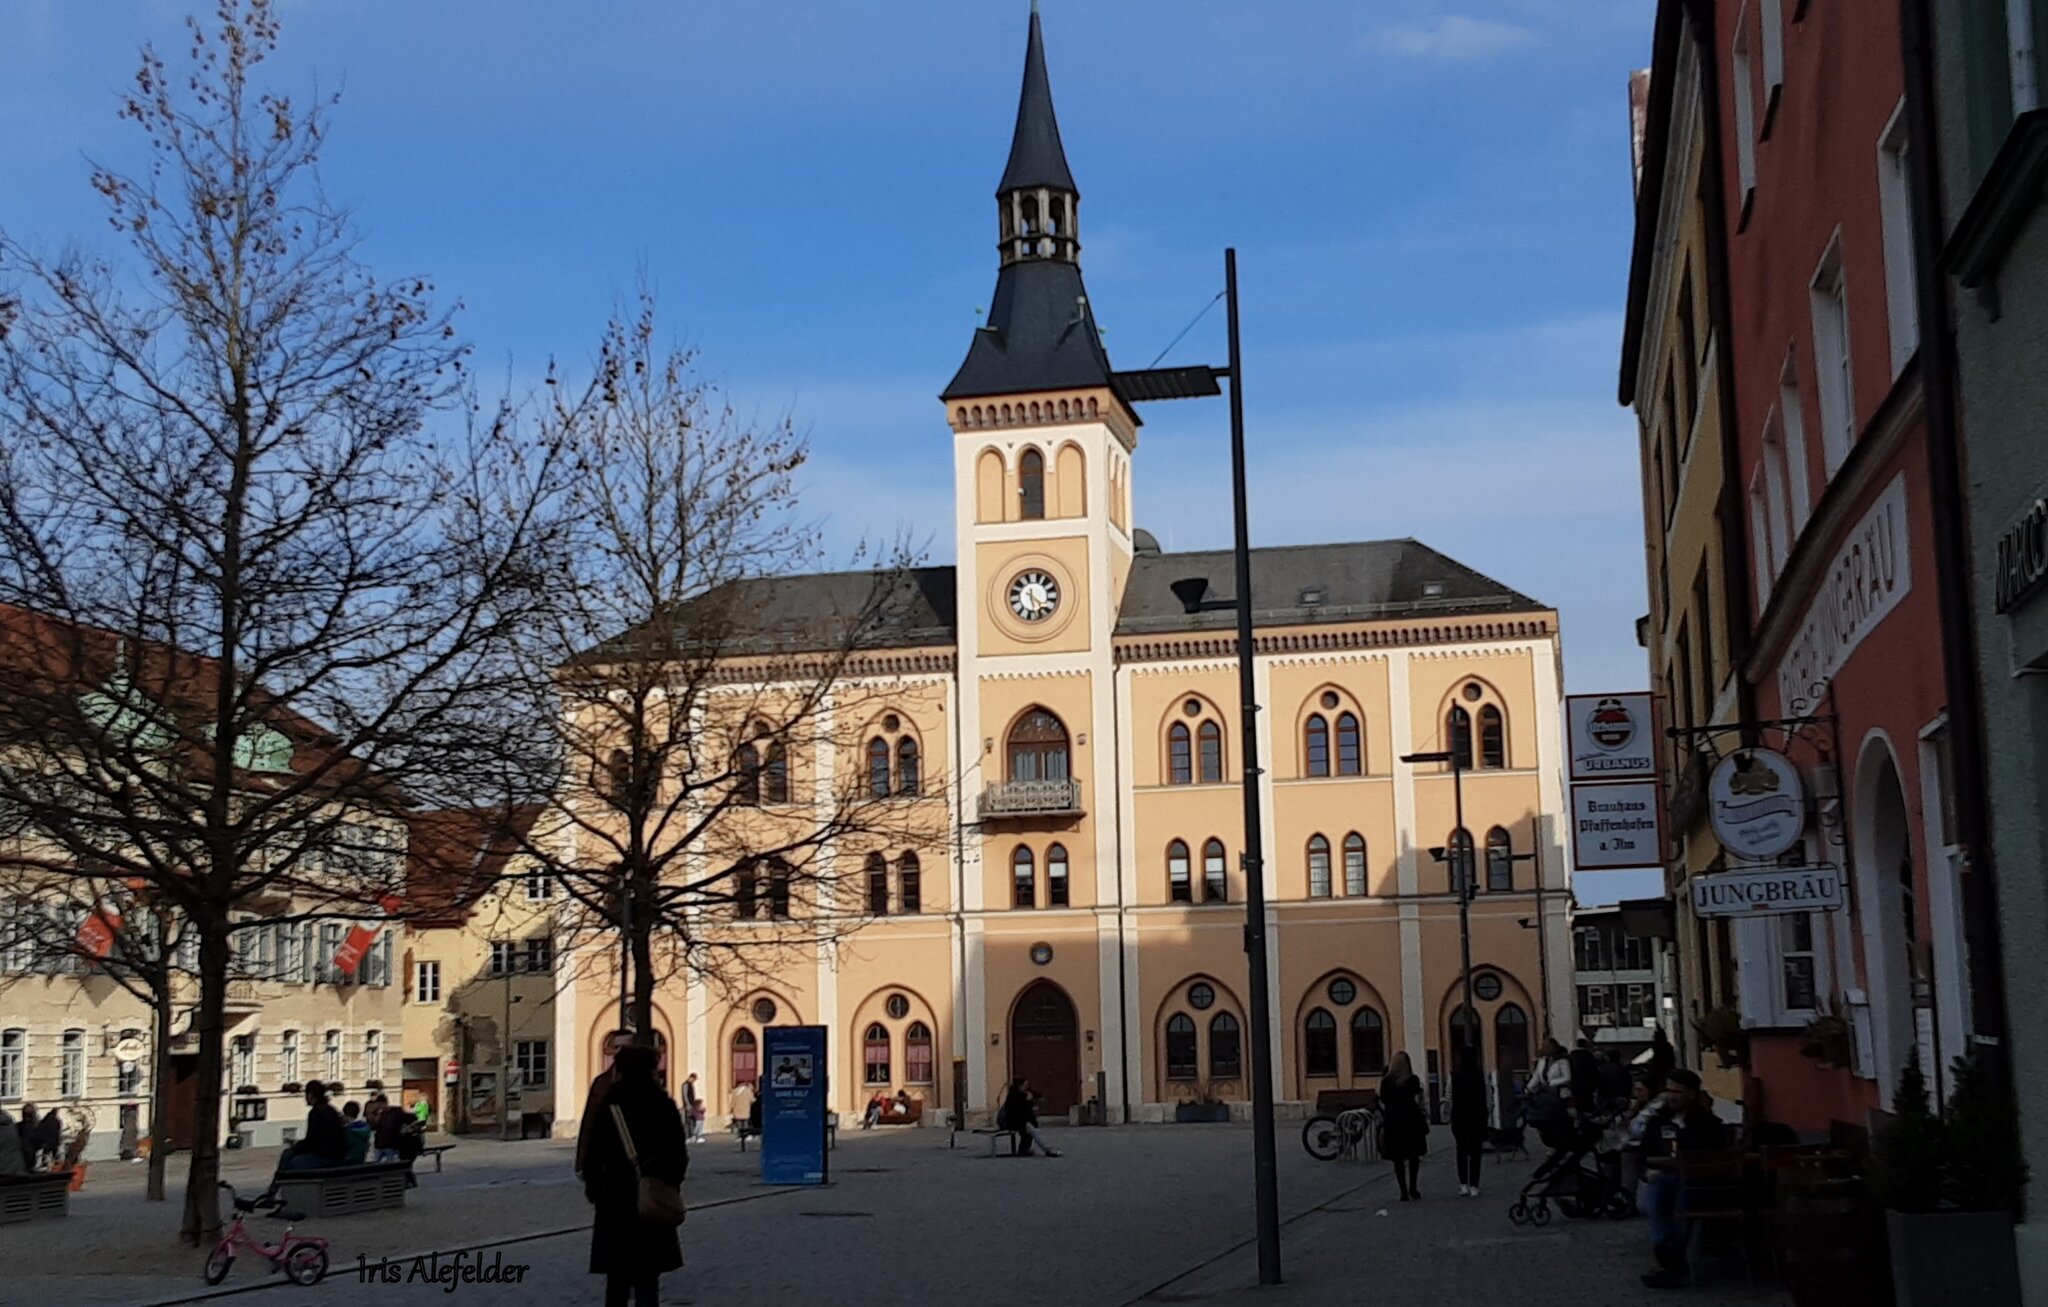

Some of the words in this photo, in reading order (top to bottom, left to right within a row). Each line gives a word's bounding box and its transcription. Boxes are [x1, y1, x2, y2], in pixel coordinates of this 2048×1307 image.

[1584, 757, 1650, 771] URBANUS
[1587, 800, 1646, 813] Brauhaus
[1579, 817, 1655, 833] Pfaffenhofen
[1697, 874, 1834, 908] JUNGBRÄU
